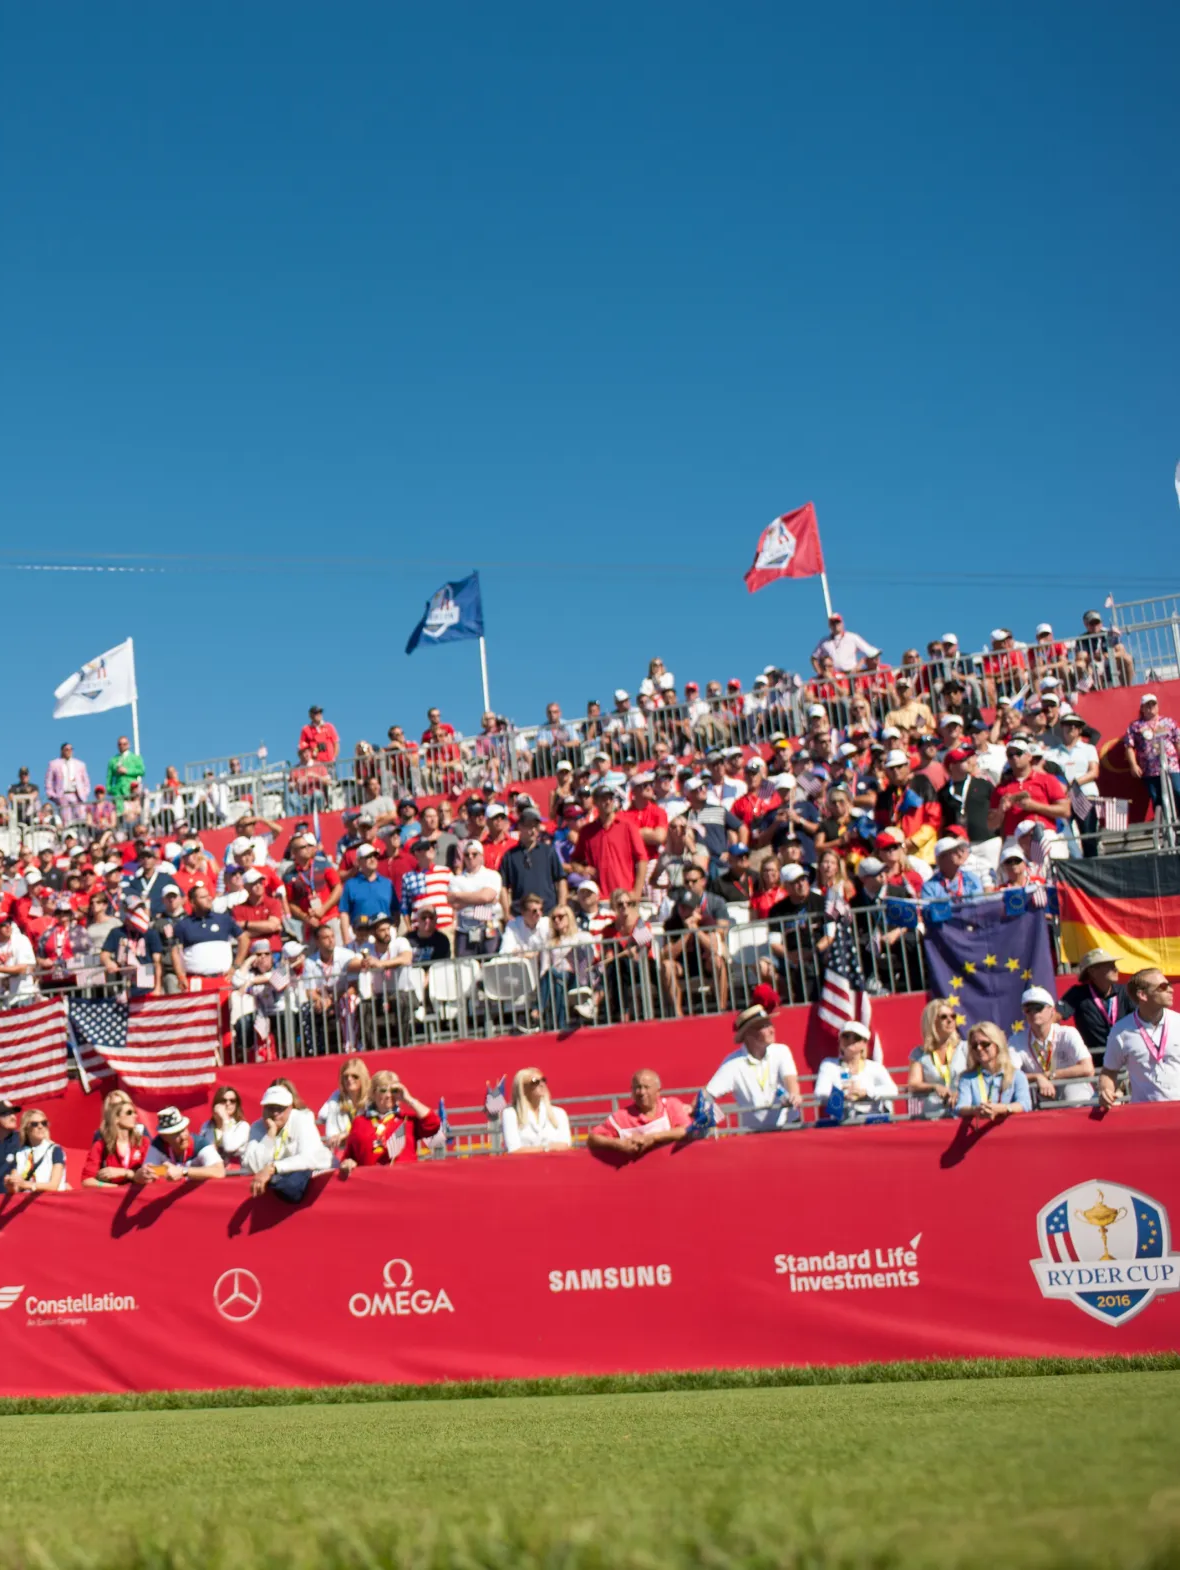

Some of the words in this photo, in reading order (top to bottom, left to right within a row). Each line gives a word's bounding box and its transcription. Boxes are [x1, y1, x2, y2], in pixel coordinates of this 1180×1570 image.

[774, 1248, 871, 1274] Standard
[875, 1246, 918, 1269] Life
[548, 1263, 672, 1293] SAMSUNG
[789, 1269, 920, 1293] Investments
[1047, 1267, 1124, 1287] RYDER
[1126, 1264, 1174, 1283] CUP
[25, 1292, 136, 1315] Constellation
[348, 1287, 455, 1318] OMEGA
[1097, 1294, 1131, 1308] 2016
